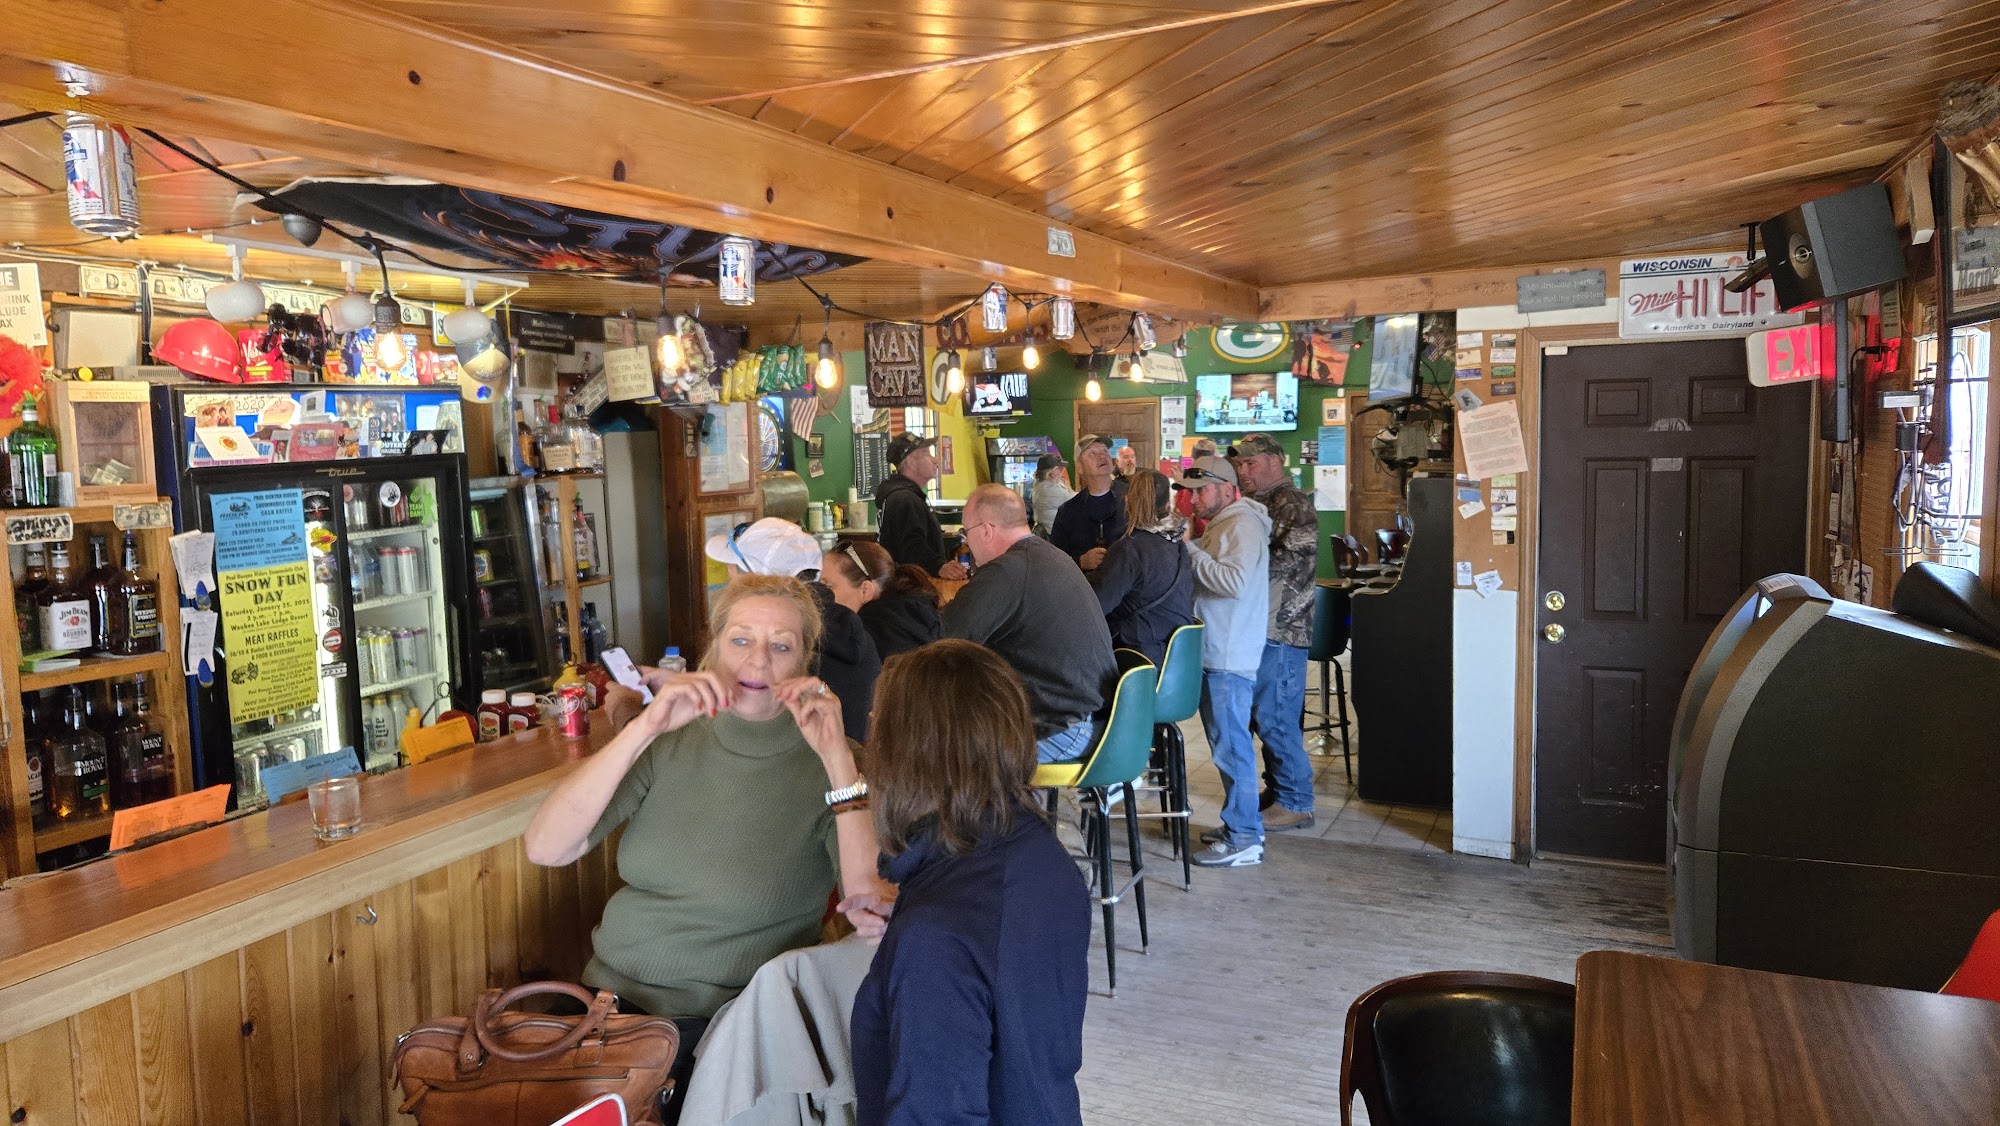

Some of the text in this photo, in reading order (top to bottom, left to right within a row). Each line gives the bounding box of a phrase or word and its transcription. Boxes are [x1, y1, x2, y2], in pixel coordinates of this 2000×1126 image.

[1632, 257, 1713, 273] WISCONSIN
[1628, 291, 1684, 315] Miller
[1677, 274, 1782, 318] HI LIF
[1663, 321, 1754, 332] America's Dairyland
[868, 328, 920, 365] MAN
[1766, 325, 1822, 382] EXI
[871, 365, 923, 397] CAVE
[225, 572, 307, 595] SNOW FUN
[253, 590, 284, 605] DAY
[59, 606, 89, 620] JIM BEAM
[225, 608, 255, 618] Saturday,
[257, 603, 280, 613] January
[256, 619, 269, 627] Lake
[272, 616, 288, 626] Lodge
[245, 628, 299, 646] MEAT RAFFLES
[80, 756, 106, 768] MOUNT
[83, 764, 104, 775] ROYAL
